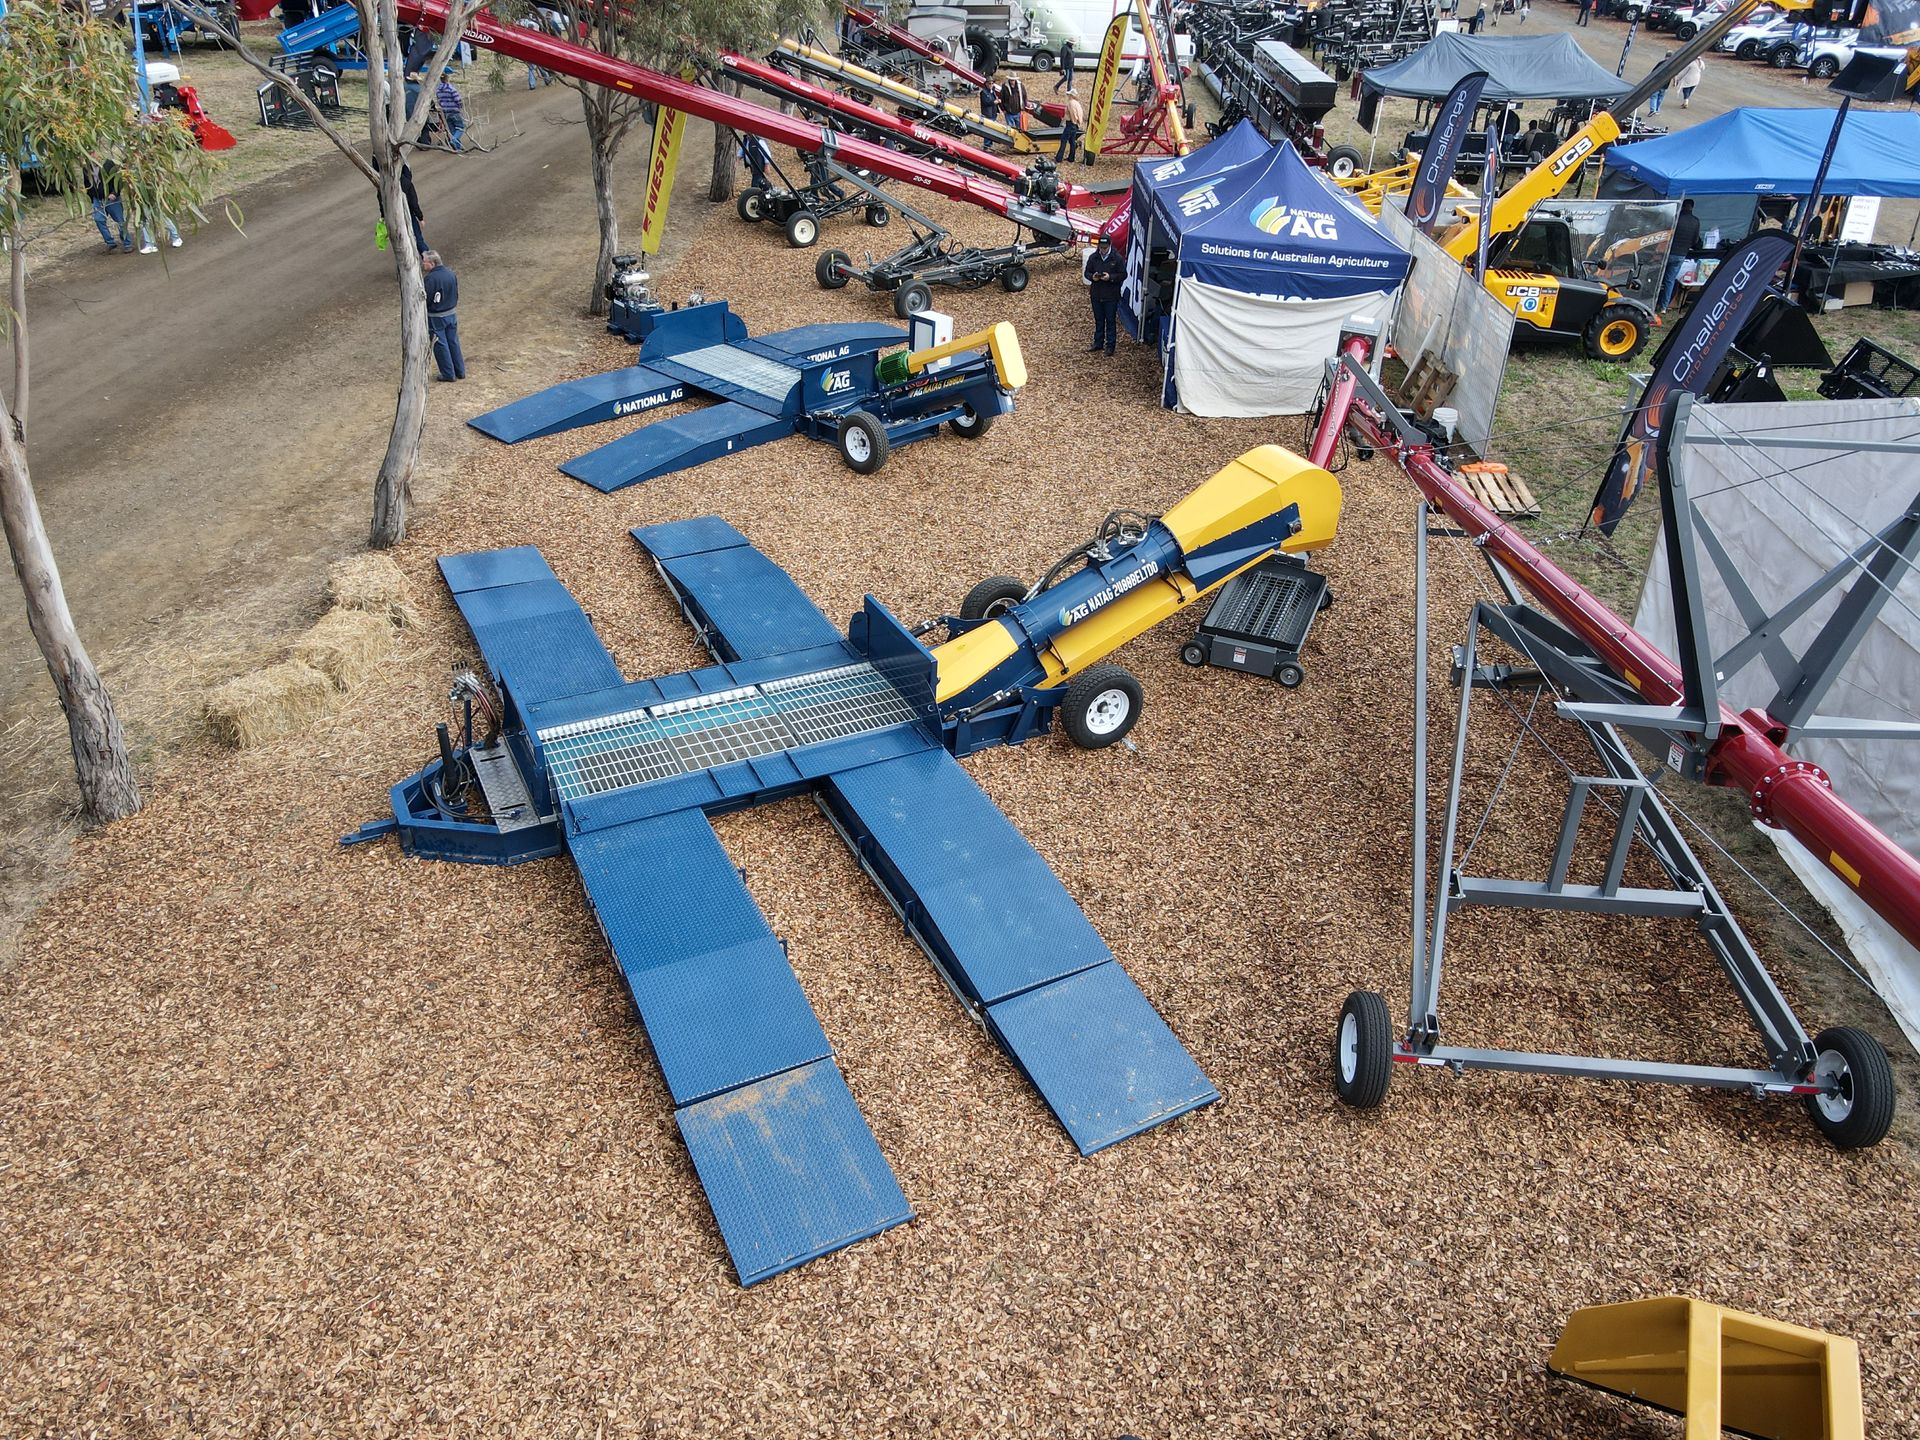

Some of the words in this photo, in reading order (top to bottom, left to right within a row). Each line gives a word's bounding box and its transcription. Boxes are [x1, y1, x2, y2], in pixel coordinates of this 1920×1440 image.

[463, 29, 489, 42] RIDIAN
[1094, 25, 1120, 124] WESTFIELD
[1427, 90, 1467, 184] Challenge
[648, 106, 676, 213] WESTFIE
[1553, 136, 1593, 176] JCB
[1178, 194, 1212, 217] AG
[1290, 208, 1336, 222] NATIONAL
[1290, 216, 1338, 240] AG
[1640, 231, 1668, 246] CASE
[1201, 243, 1250, 258] Solutions
[1252, 249, 1269, 260] for
[1271, 250, 1326, 265] Australian
[1328, 254, 1389, 268] Agriculture
[1506, 286, 1540, 297] JCB
[1673, 251, 1759, 382] Challenge
[839, 345, 849, 355] AG
[832, 374, 850, 391] AG
[622, 392, 668, 413] NATIONAL
[670, 388, 683, 400] AG
[1073, 606, 1089, 622] AG
[1087, 587, 1114, 611] NATAG
